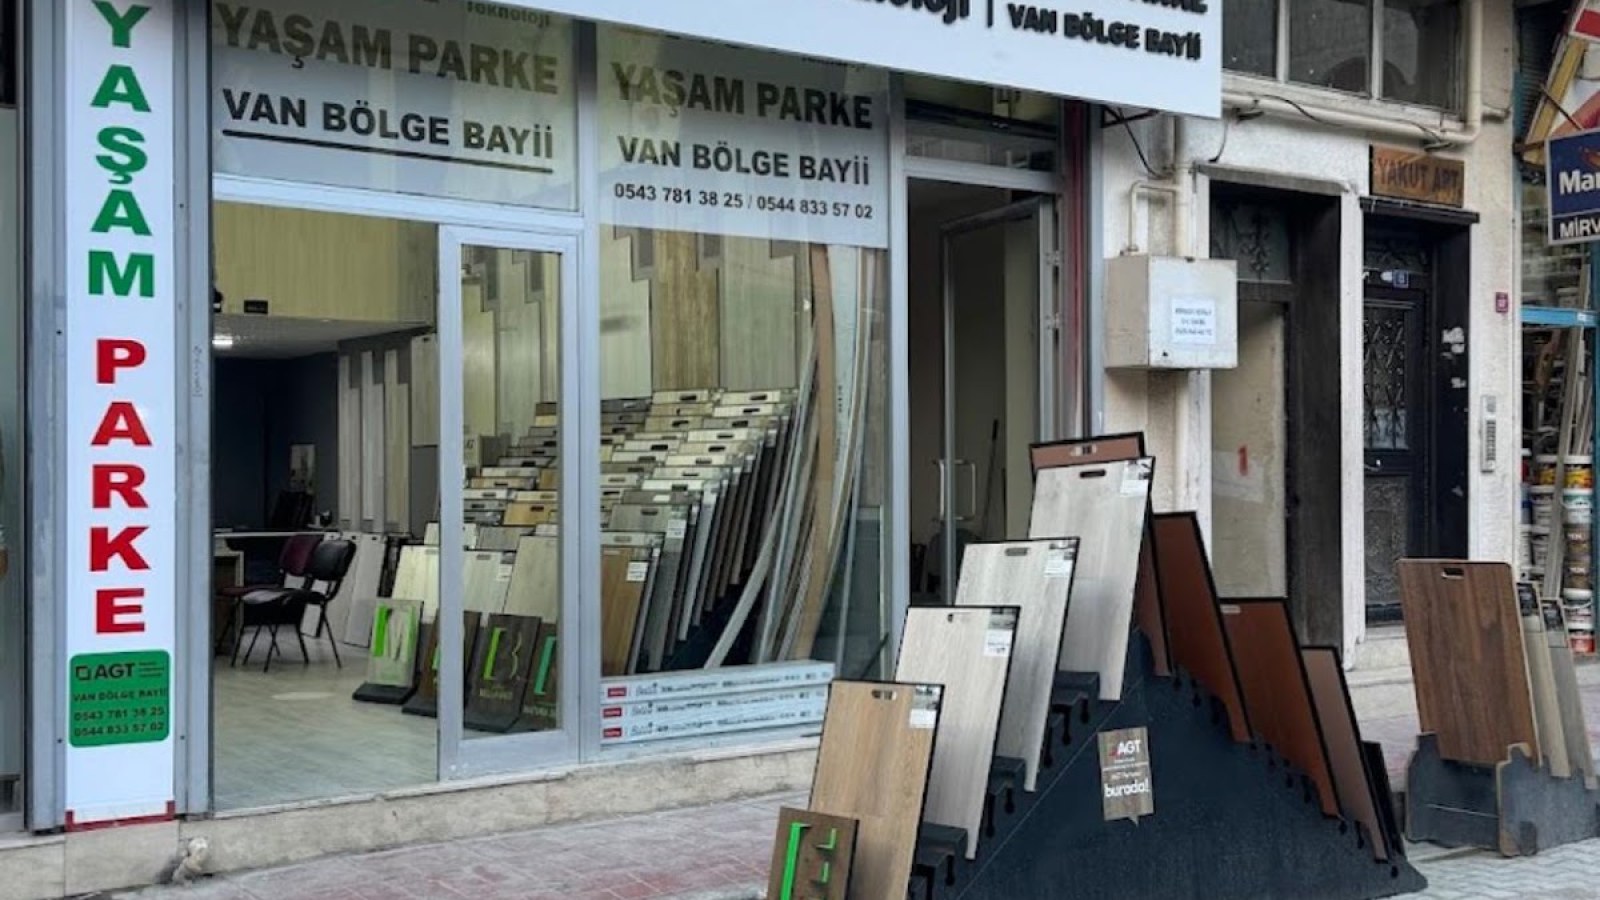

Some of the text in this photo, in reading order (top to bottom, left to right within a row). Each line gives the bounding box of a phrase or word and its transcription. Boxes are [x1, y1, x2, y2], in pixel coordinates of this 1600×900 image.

[215, 4, 559, 95] YAŞAM PARKE
[1008, 3, 1057, 34] VAN
[1063, 12, 1140, 49] BÖLGE
[222, 88, 307, 128] VAN
[322, 99, 450, 146] BÖLGE
[610, 62, 873, 129] YAŞAM PARKE
[617, 135, 681, 168] VAN
[692, 140, 790, 178] BÖLGE
[614, 183, 657, 202] 0543
[662, 187, 692, 205] 781
[698, 191, 718, 207] 38
[723, 193, 744, 209] 25
[756, 195, 796, 214] 0544
[799, 199, 828, 216] 833
[832, 203, 850, 218] 57
[854, 204, 873, 220] 02
[87, 0, 155, 635] YAŞAM PARKE
[94, 662, 134, 679] AGT
